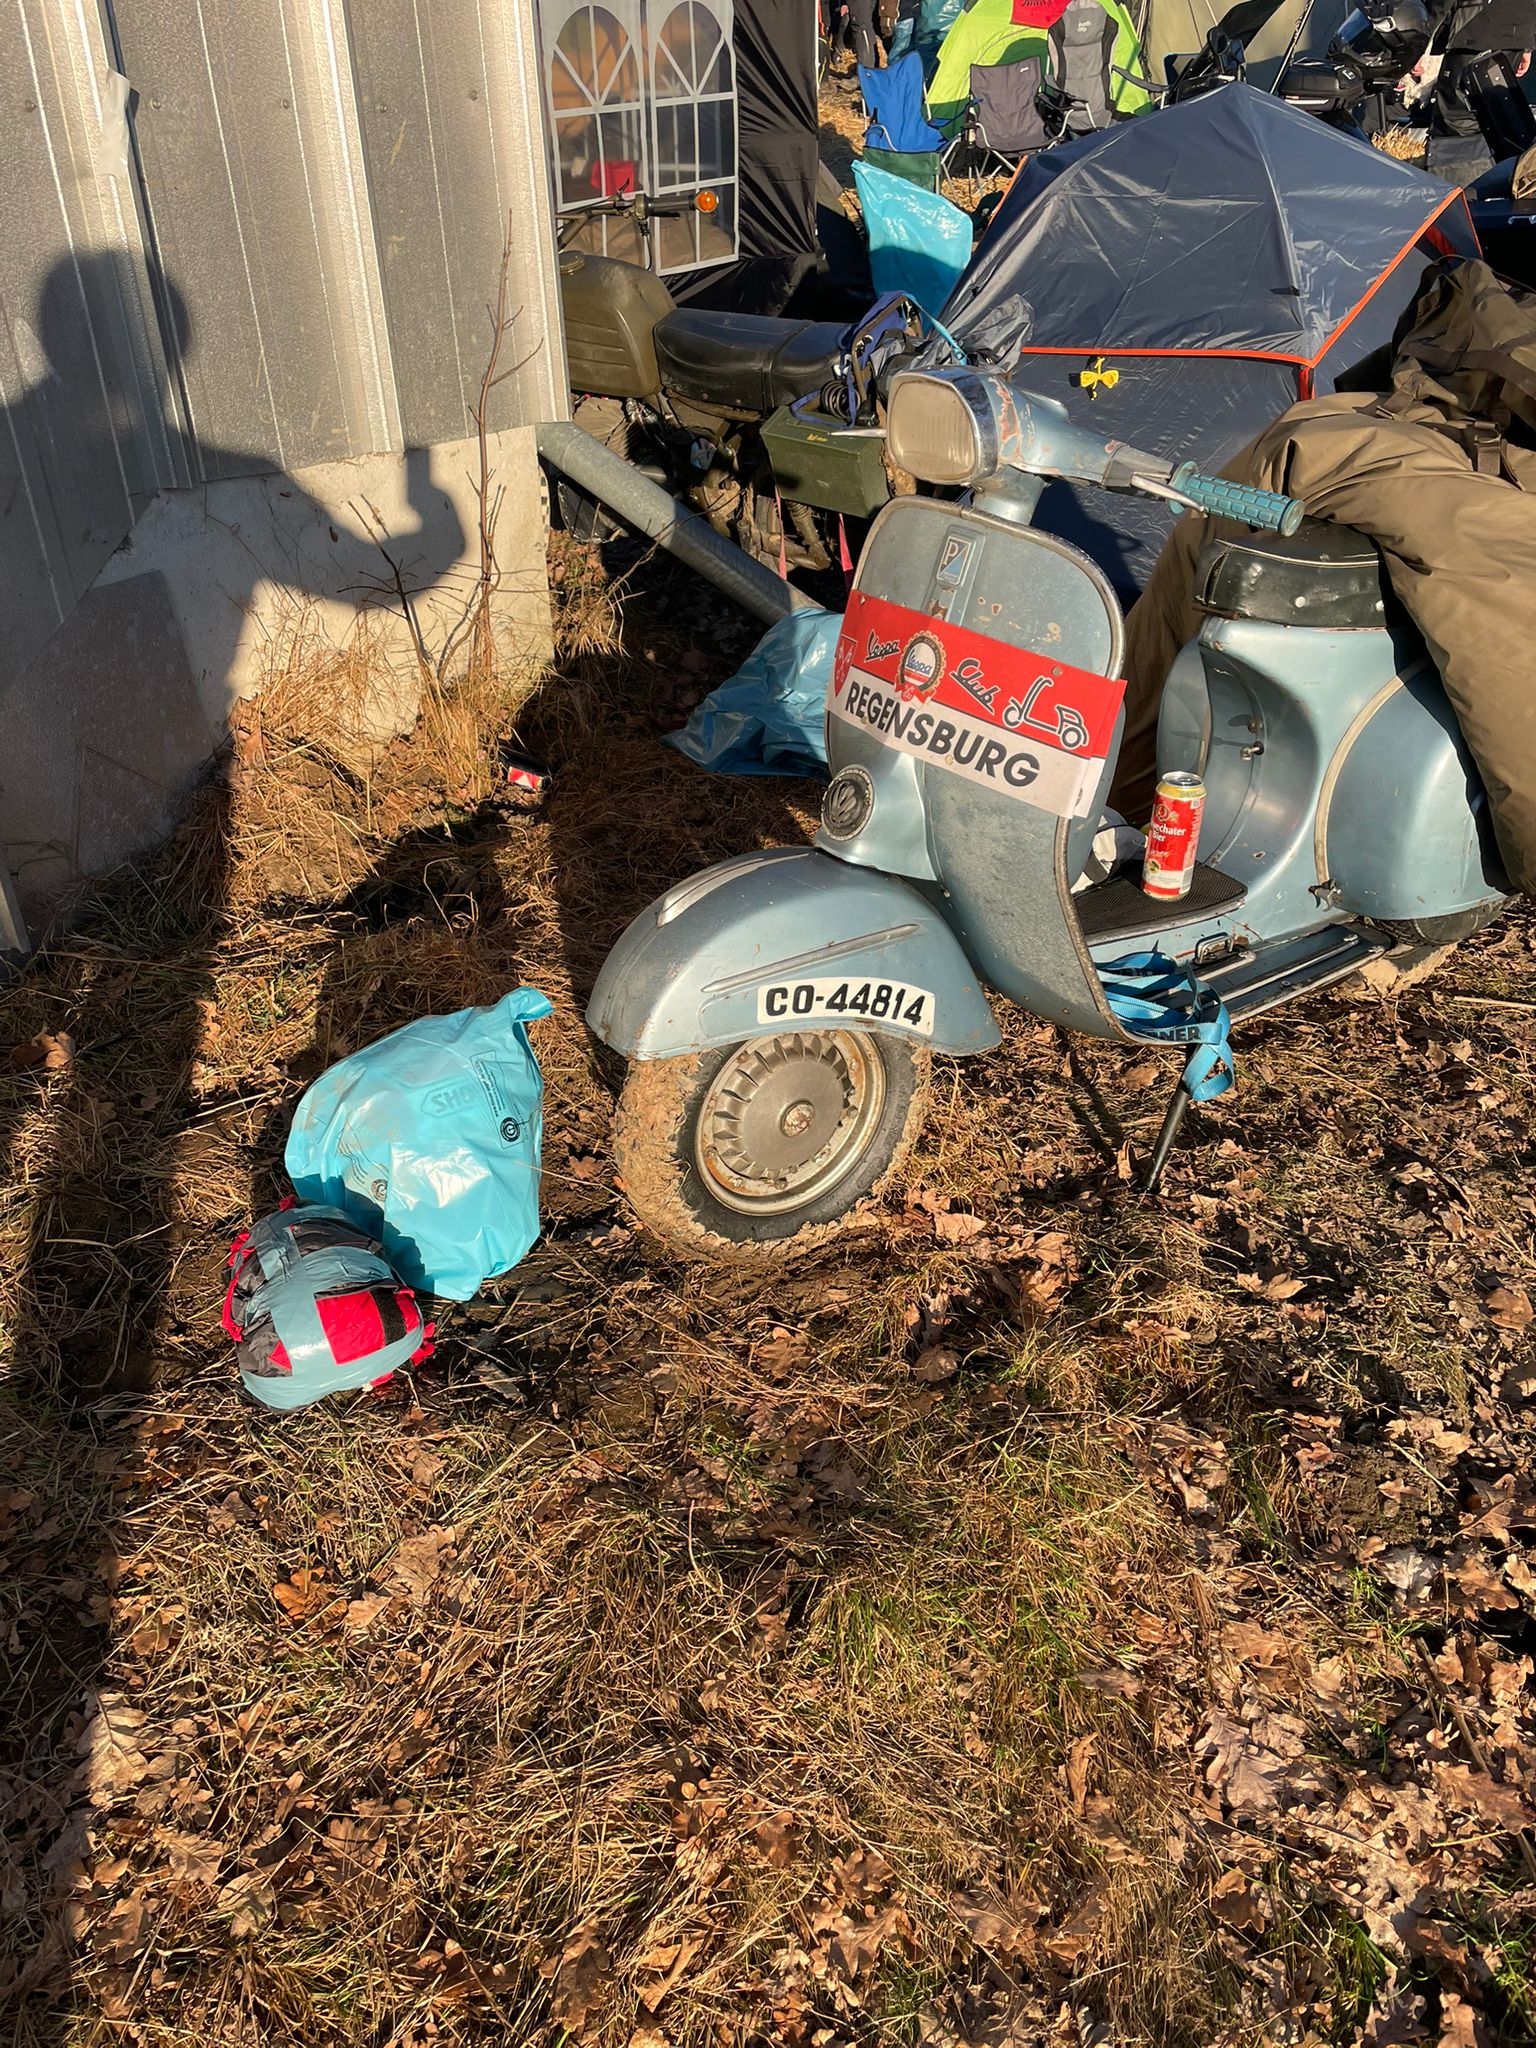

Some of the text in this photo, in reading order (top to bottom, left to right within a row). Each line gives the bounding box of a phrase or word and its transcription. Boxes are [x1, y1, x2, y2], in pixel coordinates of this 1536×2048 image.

[865, 629, 901, 662] Vespa
[949, 658, 999, 714] Club
[845, 681, 1040, 787] REGENSBURG
[765, 983, 926, 1026] CO-44814
